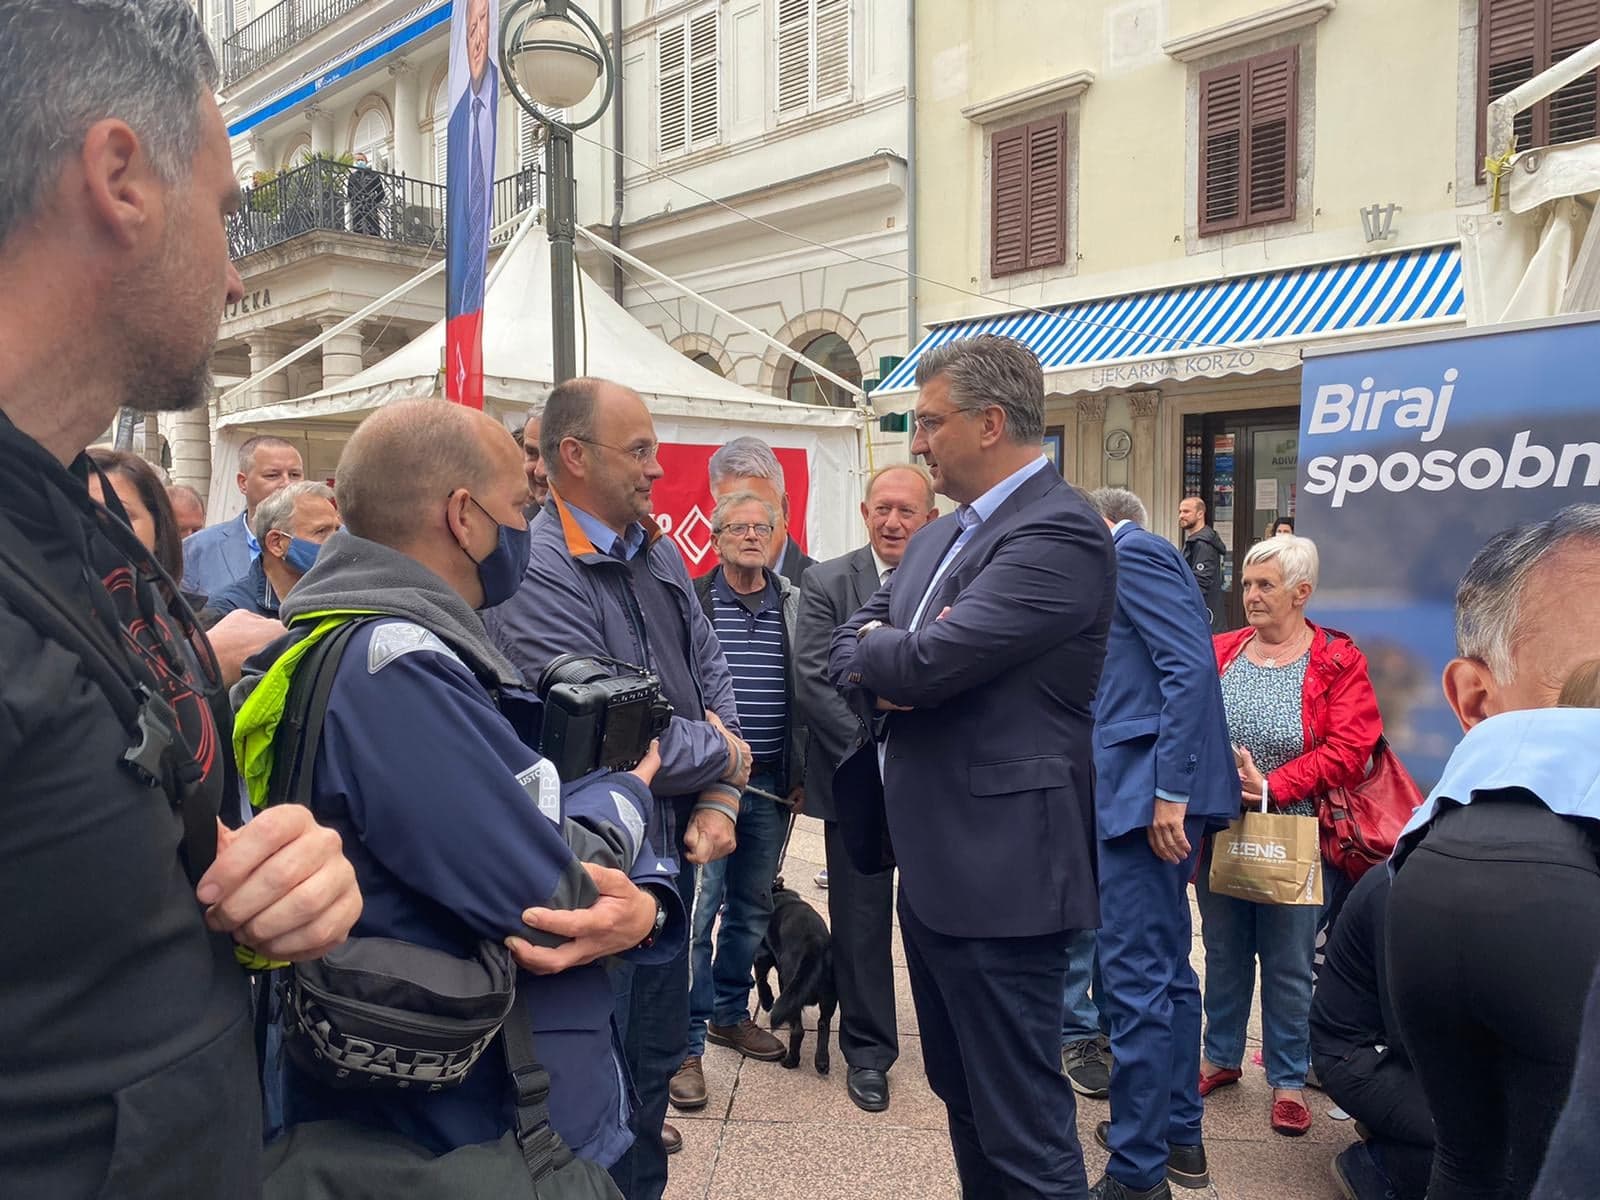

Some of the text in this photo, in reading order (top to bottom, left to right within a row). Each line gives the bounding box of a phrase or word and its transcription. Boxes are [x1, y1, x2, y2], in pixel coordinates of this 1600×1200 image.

[224, 288, 271, 318] IJEKA
[1091, 351, 1255, 386] LJEKARNA KORZO
[1308, 368, 1459, 442] Biraj
